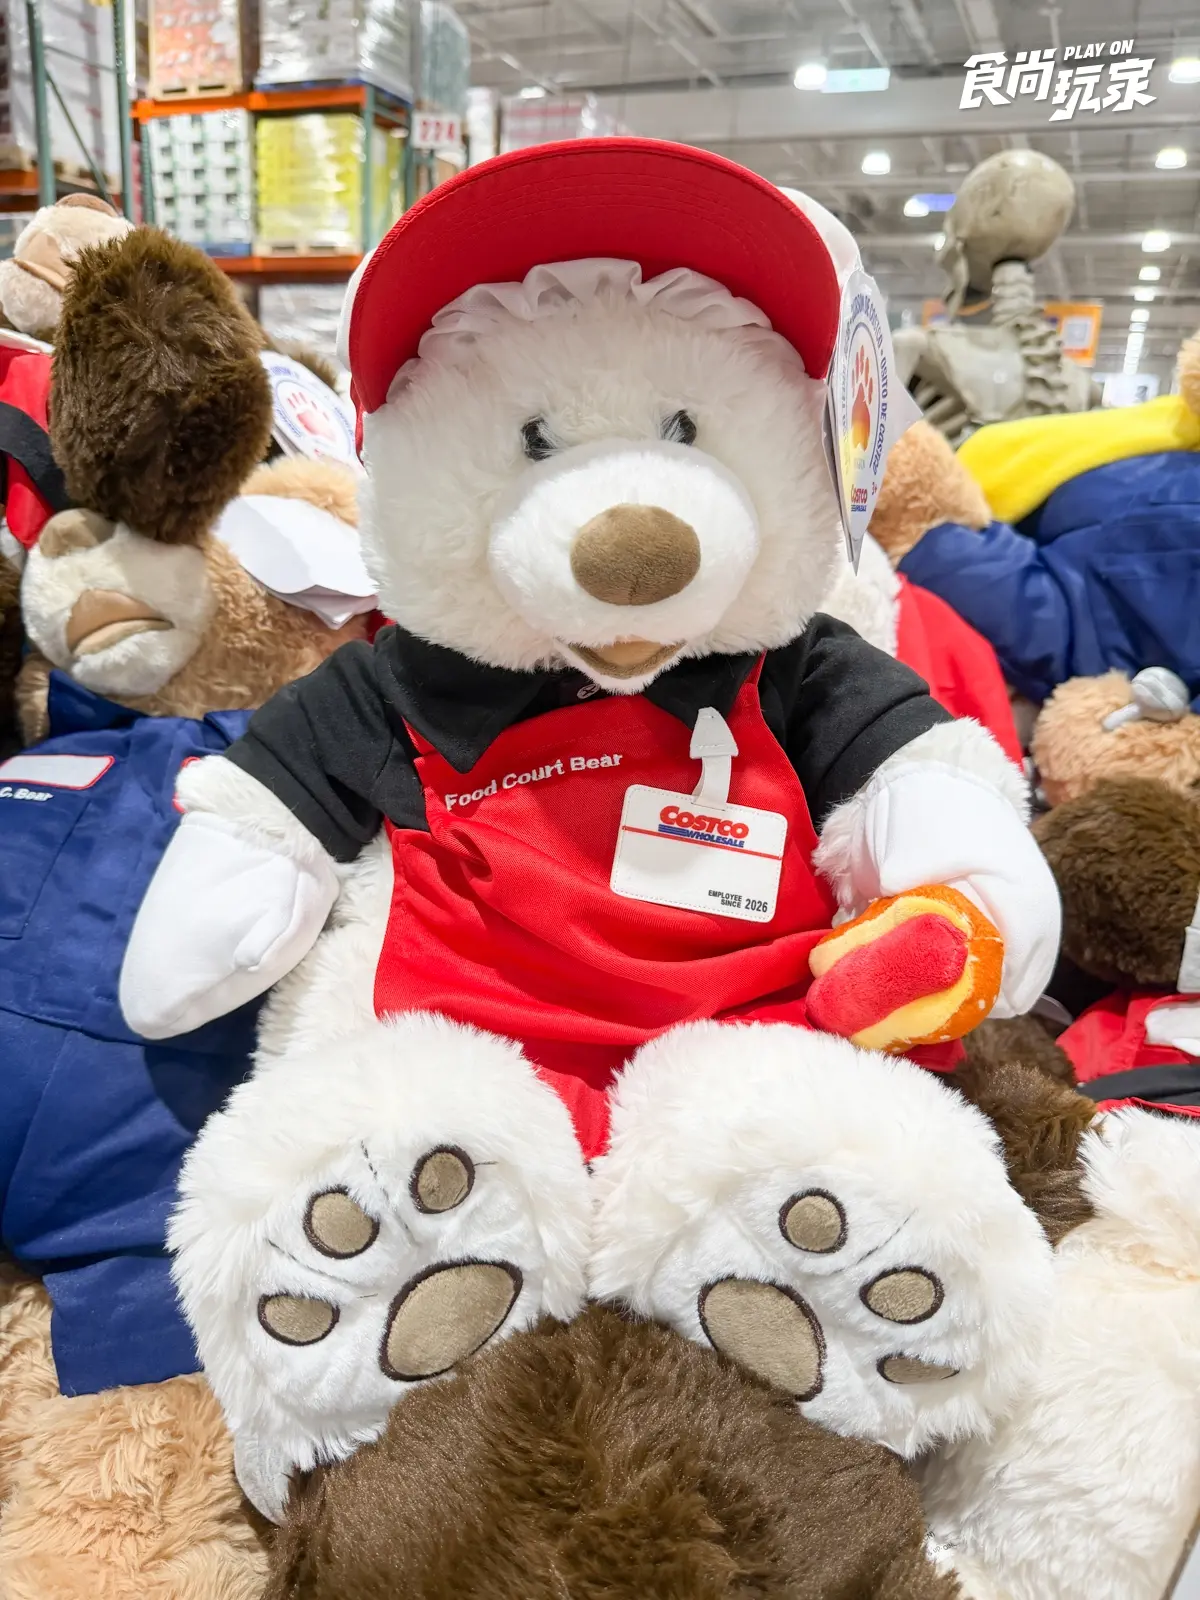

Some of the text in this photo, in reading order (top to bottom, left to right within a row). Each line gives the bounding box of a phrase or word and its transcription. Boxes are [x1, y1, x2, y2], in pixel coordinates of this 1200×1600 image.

[872, 356, 888, 476] OSITO DE COSTCO
[444, 753, 623, 812] Food Court Bear
[659, 805, 749, 839] COSTCO
[686, 829, 745, 848] WHOLESALE
[708, 889, 743, 902] EMPLOYEE
[720, 898, 768, 913] SINCE 2026
